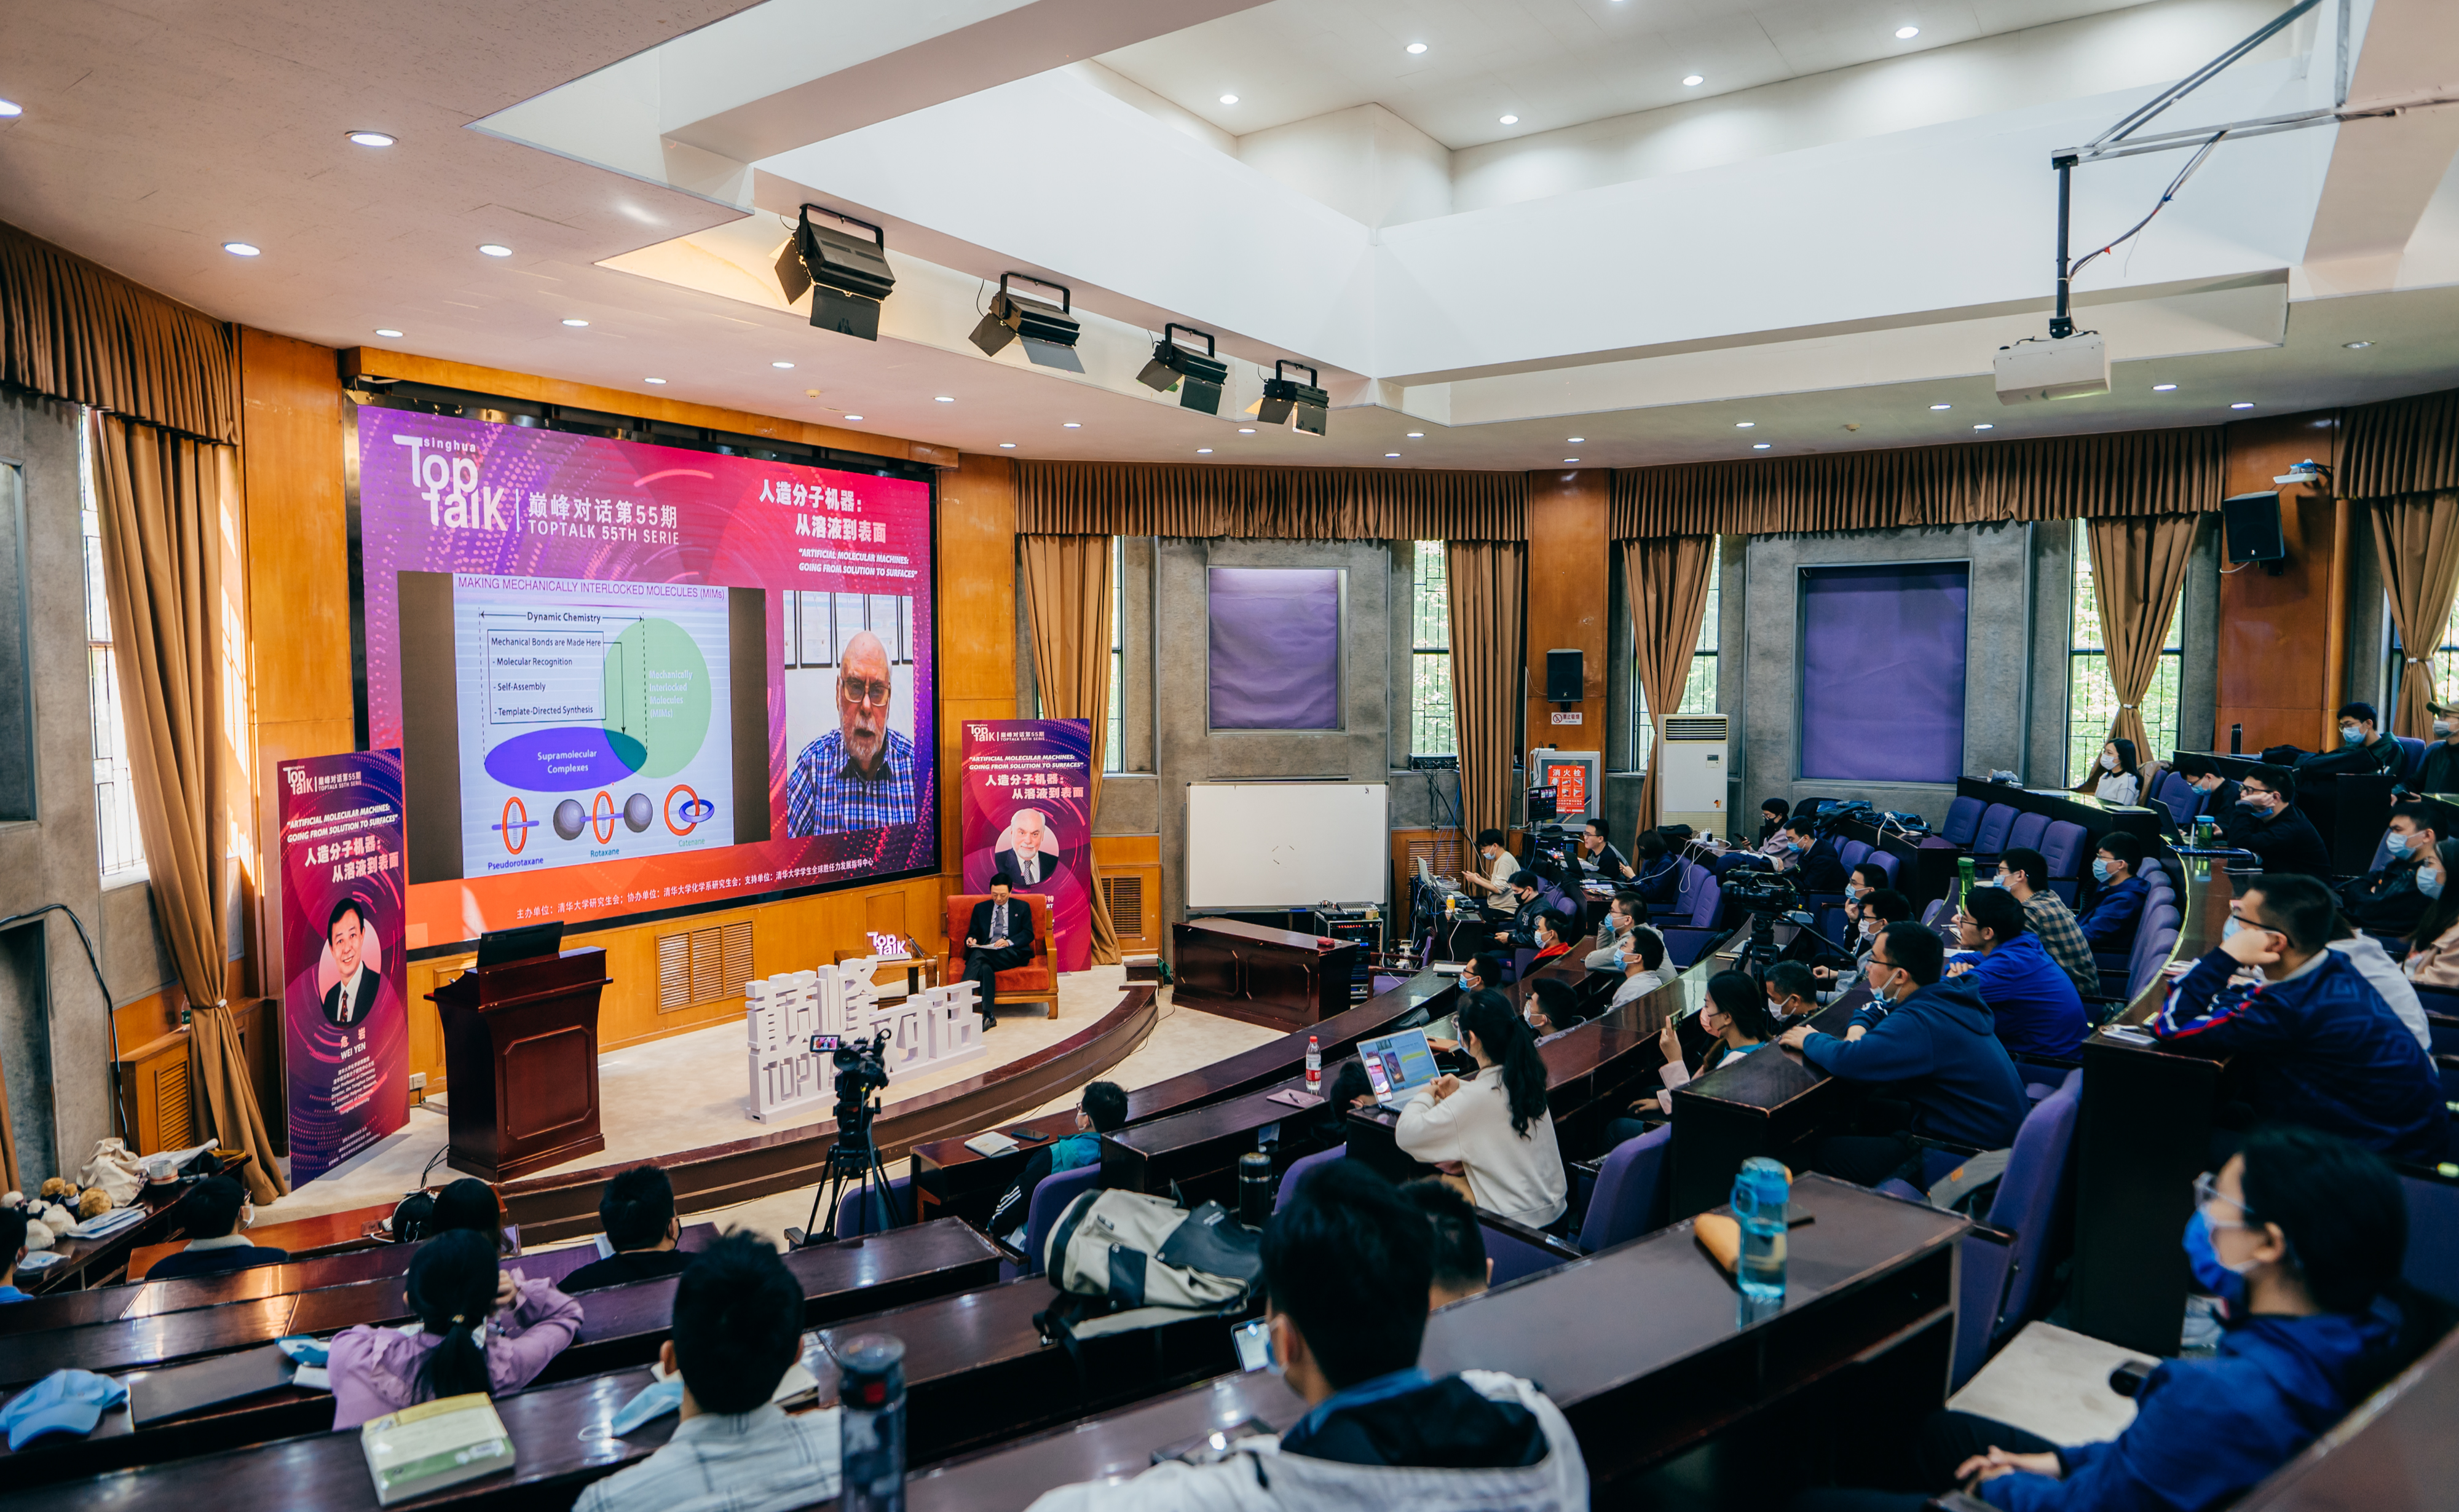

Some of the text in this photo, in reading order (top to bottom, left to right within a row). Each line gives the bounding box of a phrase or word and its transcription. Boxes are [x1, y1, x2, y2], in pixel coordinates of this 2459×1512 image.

[392, 434, 478, 492] Top
[528, 492, 677, 529] 巅峰对话第55期
[528, 519, 679, 545] TOPTALK 55TH SERIE
[795, 513, 886, 543] 从溶液到表面
[837, 551, 875, 562] MOLECULAR
[876, 554, 909, 564] MACHINES:
[799, 562, 822, 572] GOING
[823, 564, 842, 573] FROM
[843, 565, 875, 576] SOLUTION
[876, 567, 885, 577] TO
[458, 577, 725, 600] MAKING MECHANICALLY INTERLOCKED MOLECULES (MIMs)
[527, 612, 601, 624] Dynamic Chemistry
[491, 637, 531, 647] Mechanical
[532, 637, 553, 647] Bonds
[566, 638, 585, 647] Made
[586, 639, 601, 647] Here
[497, 657, 573, 667] Molecular Recognition
[649, 669, 693, 680] Mechanically
[497, 682, 546, 692] Self-Assembly
[649, 682, 687, 691] Interlocked
[649, 695, 684, 705] Molecules
[498, 705, 593, 718] Template-Directed Synthesis
[537, 749, 598, 762] Supramolecular
[547, 763, 589, 775] Complexes
[1012, 787, 1084, 800] 从溶液到表面
[323, 809, 359, 822] MOLECULAR
[360, 803, 390, 816] MACHINES:
[287, 831, 309, 843] GOING
[310, 828, 328, 839] FROM
[329, 822, 359, 835] SOLUTION
[678, 838, 705, 848] Catenane
[590, 848, 620, 858] Rotaxane
[332, 851, 399, 883] 从溶液到表面
[487, 856, 544, 870] Pseudorotaxane
[867, 931, 897, 947] Top
[341, 1042, 366, 1060] WEI YEN
